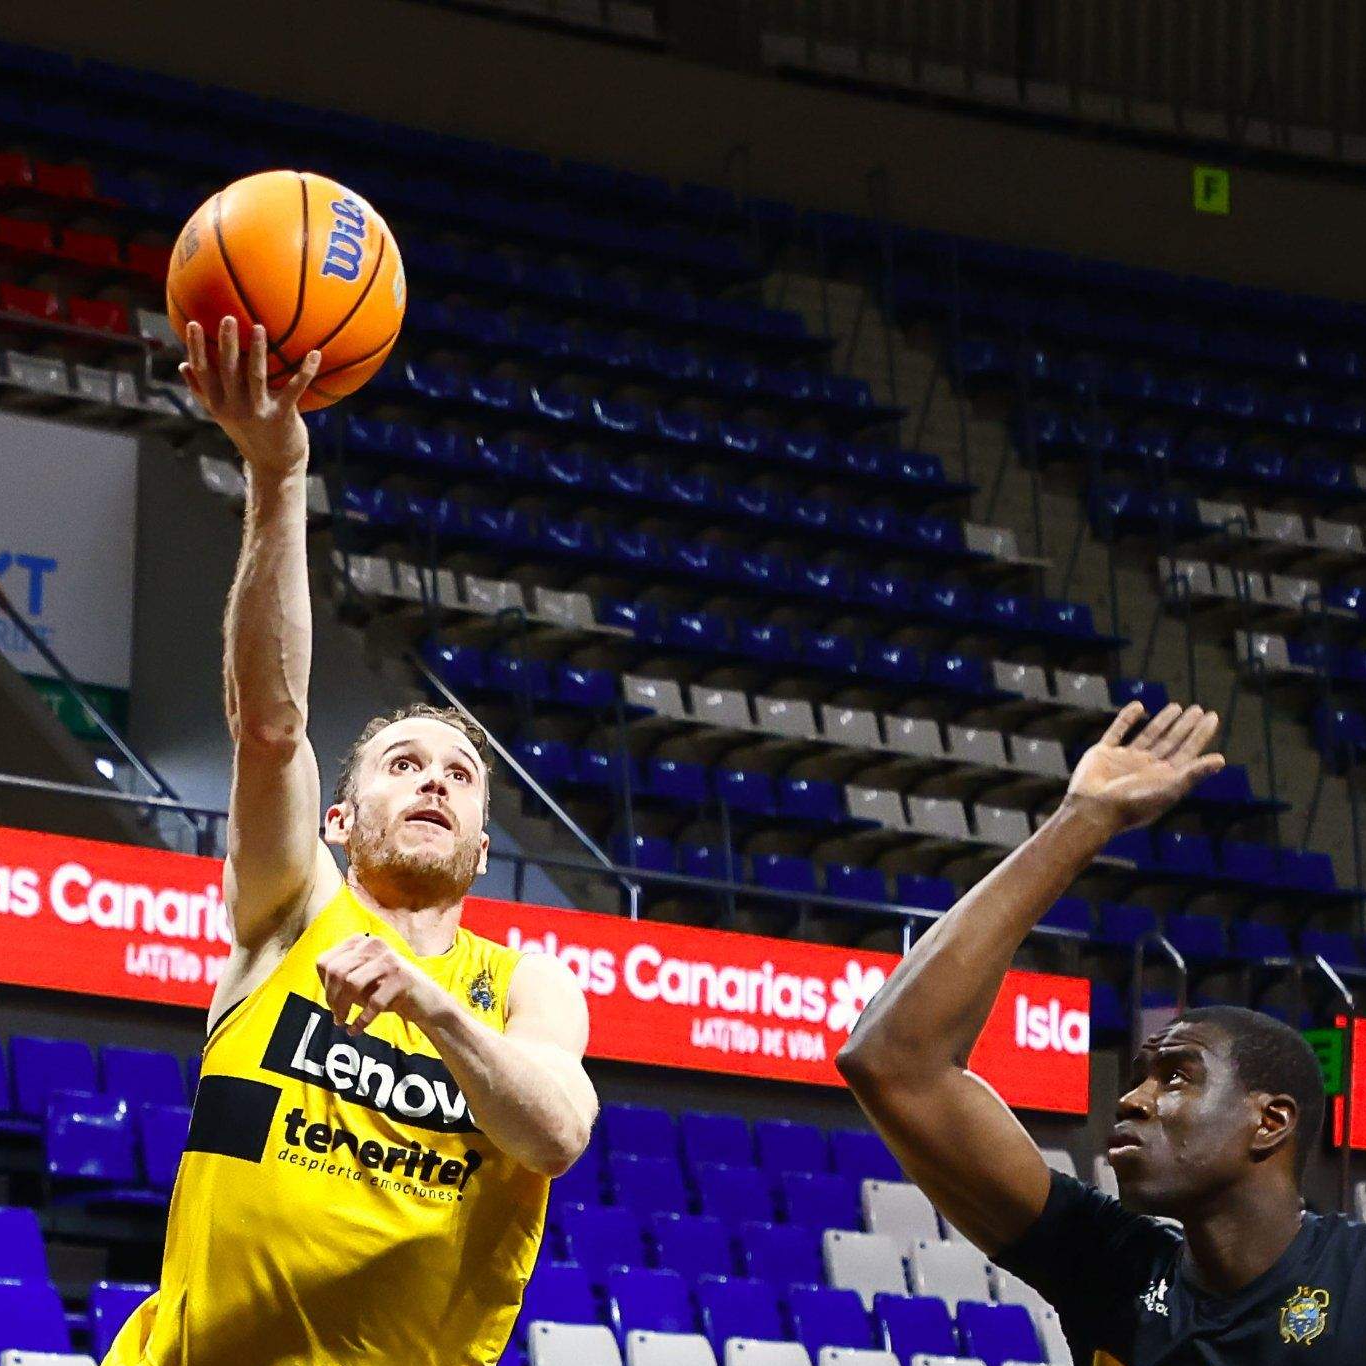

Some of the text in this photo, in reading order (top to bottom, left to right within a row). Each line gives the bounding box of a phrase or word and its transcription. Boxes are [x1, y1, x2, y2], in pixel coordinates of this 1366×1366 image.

[624, 943, 827, 1025] Canarias
[1016, 995, 1090, 1054] Isla
[291, 1012, 477, 1125] Lenov
[278, 1148, 454, 1202] despierta emociones
